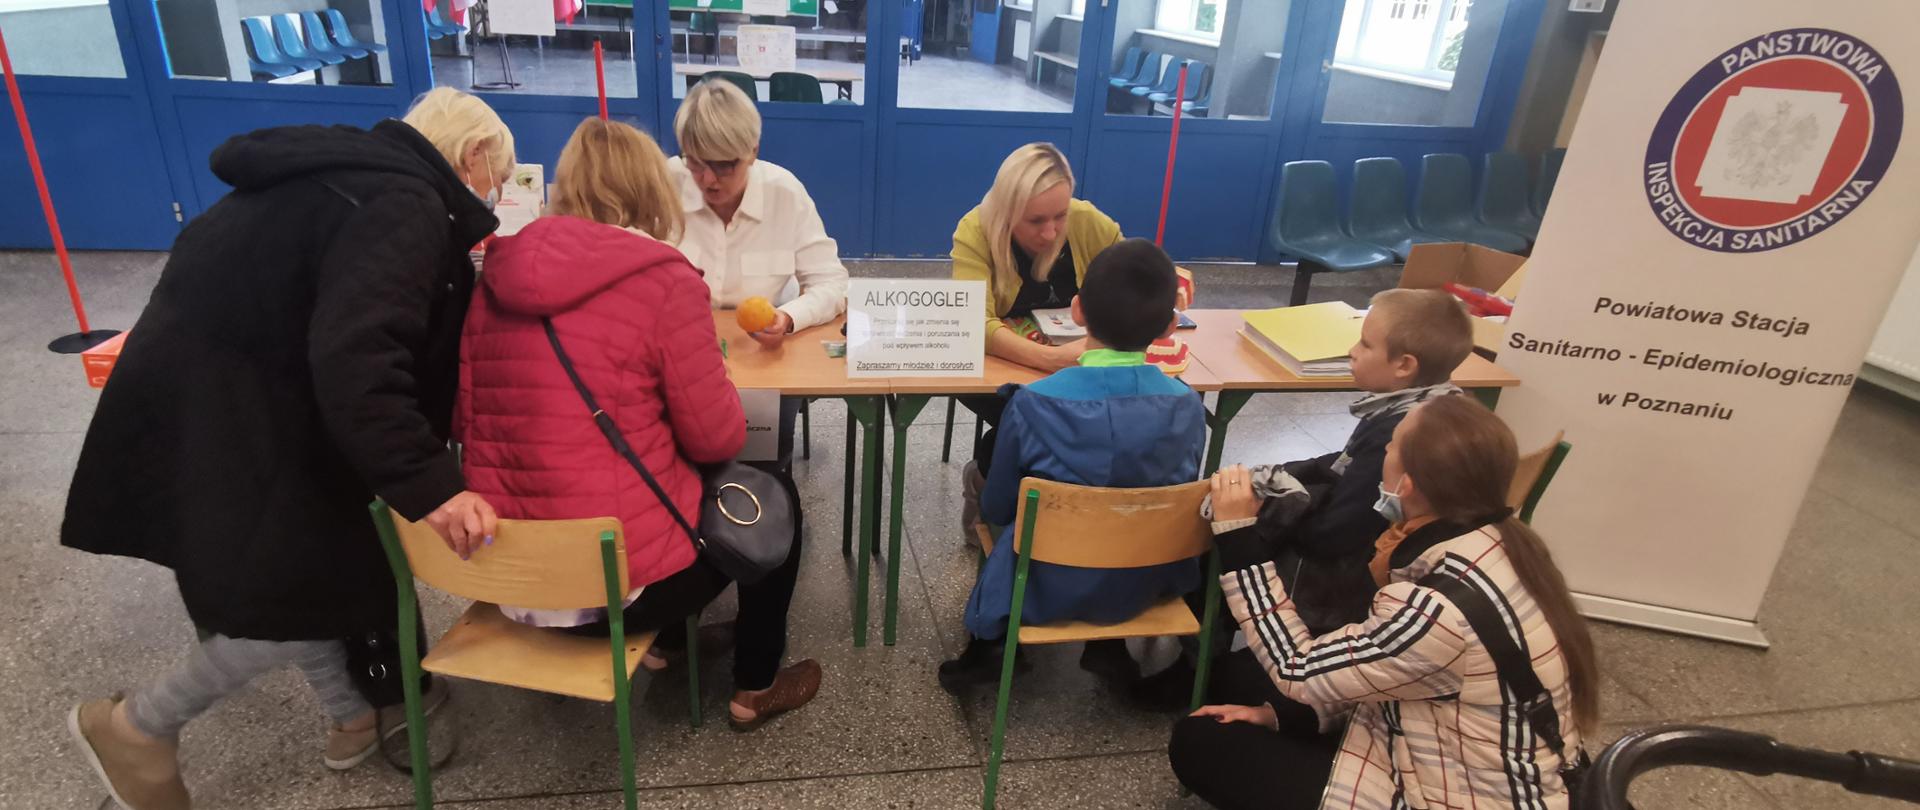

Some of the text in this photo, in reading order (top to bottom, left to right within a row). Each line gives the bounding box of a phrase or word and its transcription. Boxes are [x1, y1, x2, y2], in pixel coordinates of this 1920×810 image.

[1721, 32, 1883, 84] PAŃSTWOWA
[1648, 161, 1874, 250] INSPEKCJA SANITARNA
[864, 290, 969, 307] ALKOGOGLE!
[1593, 296, 1811, 338] Powiatowa Stacja
[856, 360, 901, 371] Zapraszamy
[903, 361, 935, 370] młodzież
[1507, 331, 1622, 362] Sanitarno
[1642, 348, 1855, 387] Epidemiologiczna
[1596, 391, 1734, 421] w Poznaniu
